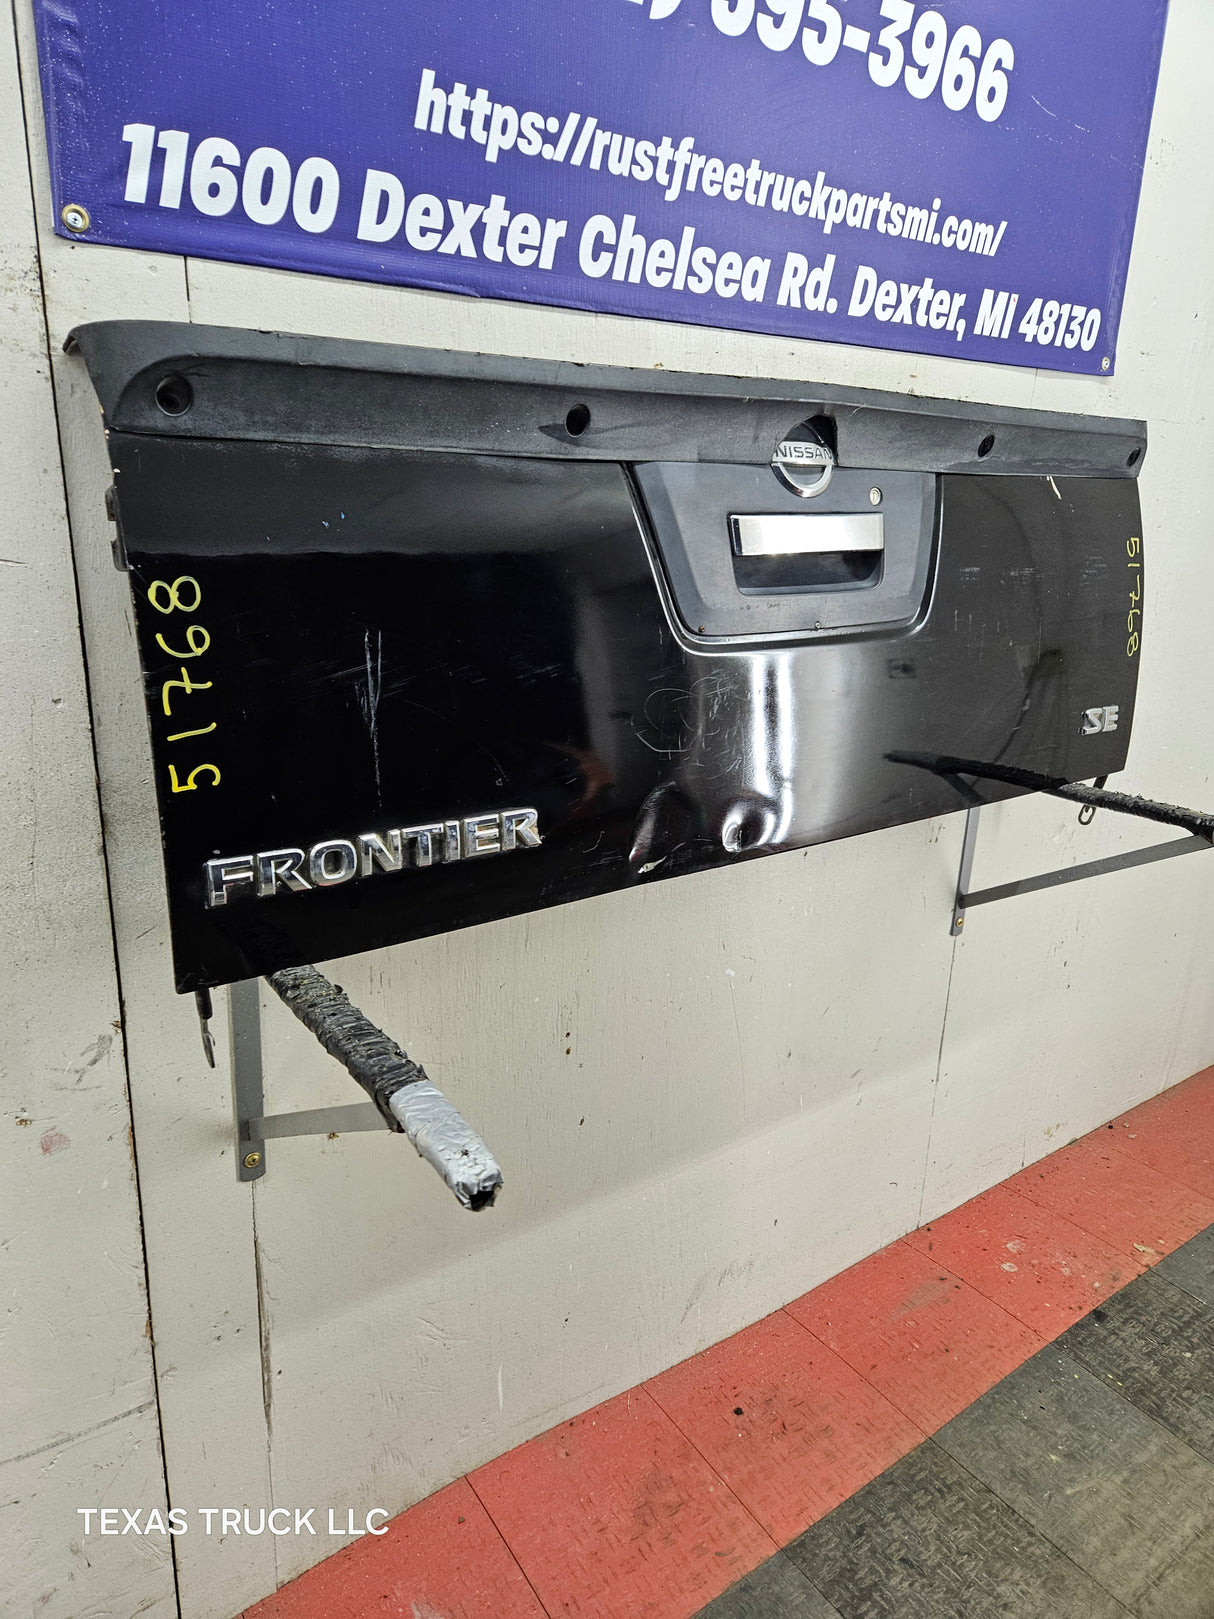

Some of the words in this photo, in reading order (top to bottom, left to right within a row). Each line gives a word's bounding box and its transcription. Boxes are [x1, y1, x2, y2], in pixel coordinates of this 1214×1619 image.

[413, 68, 1009, 257] https://rustfreetruckpartsmi.com/
[121, 122, 340, 234] 11600
[356, 168, 568, 271] Dexter
[578, 214, 772, 303] Chelsea
[776, 251, 838, 315] Rd.
[847, 264, 967, 342] Dexter,
[973, 288, 1020, 339] MI
[1017, 297, 1102, 352] 48130
[775, 445, 834, 461] NISSAN
[1126, 537, 1141, 658] 51768
[147, 576, 221, 794] 51768
[1080, 705, 1120, 736] SE
[204, 808, 543, 908] FRONTIER
